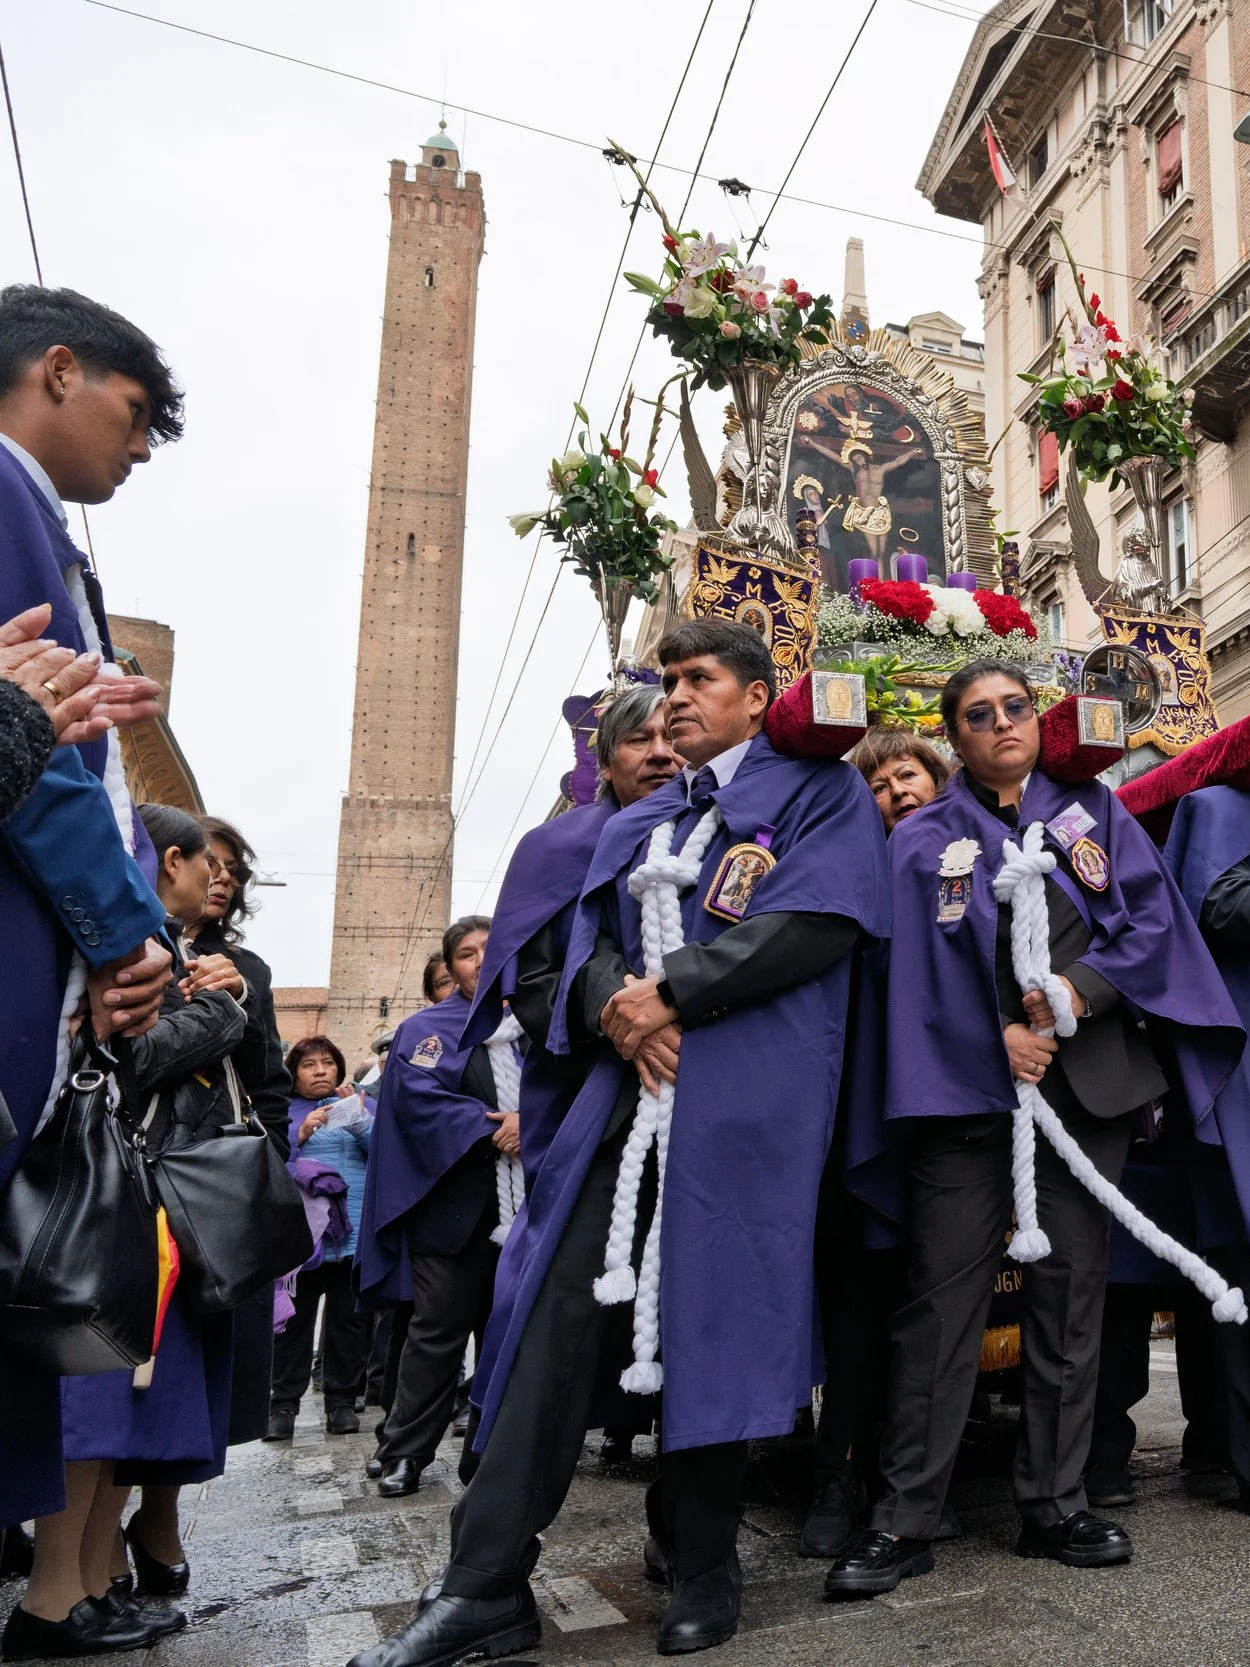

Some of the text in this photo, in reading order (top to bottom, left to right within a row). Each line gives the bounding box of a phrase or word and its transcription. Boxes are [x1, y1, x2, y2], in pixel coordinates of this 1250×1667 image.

[1158, 706, 1199, 719] OGNA
[952, 880, 962, 893] 2
[427, 1040, 436, 1050] 2
